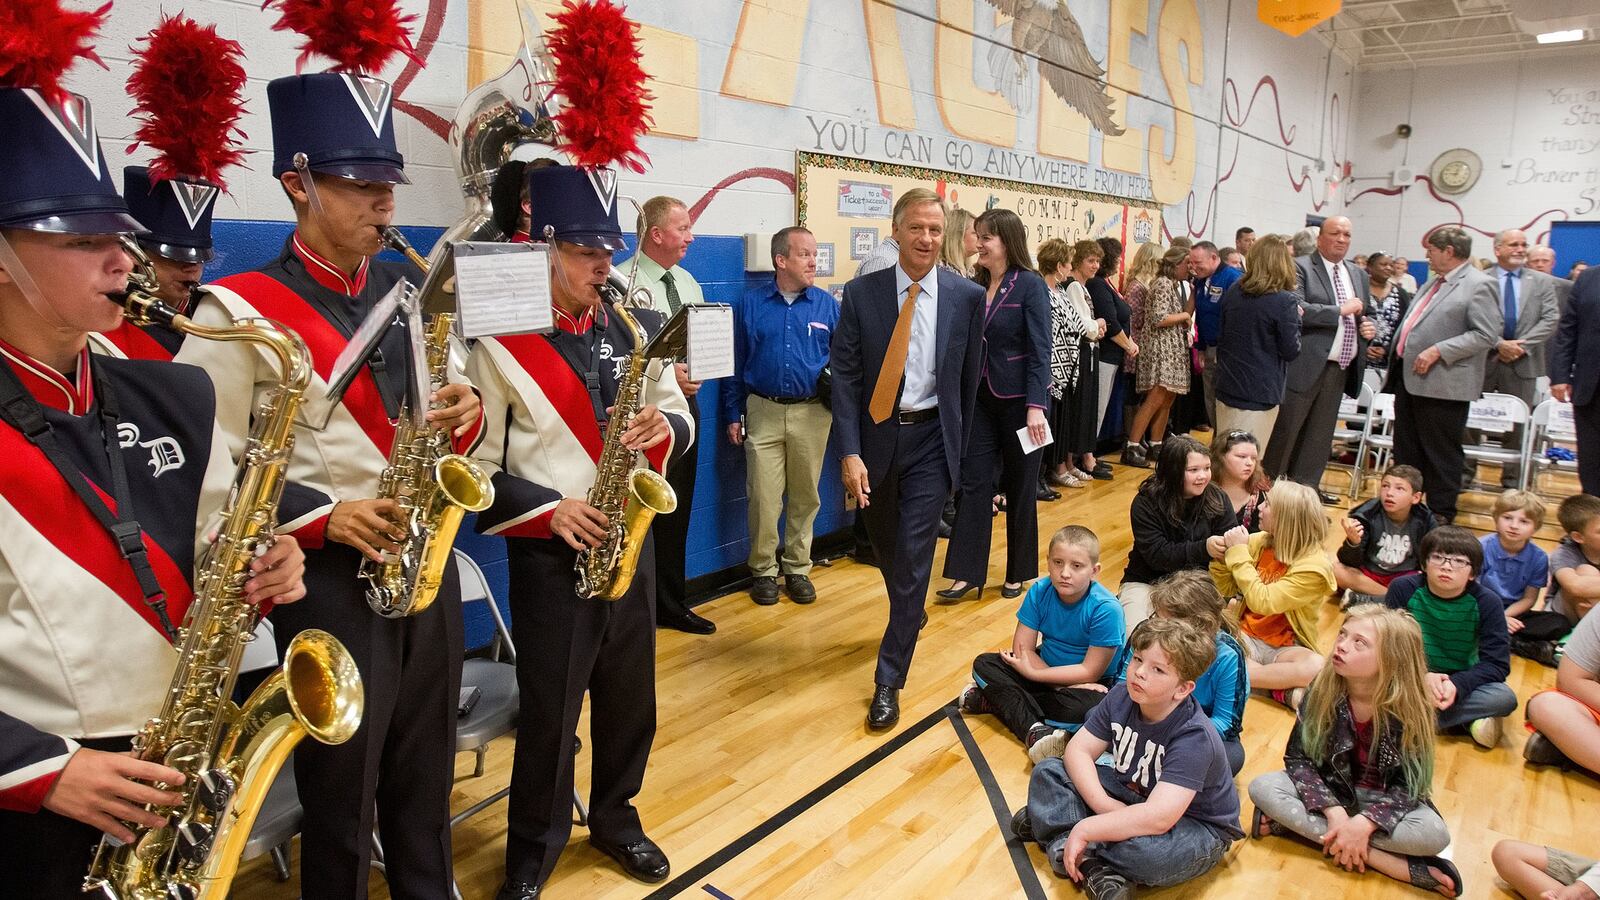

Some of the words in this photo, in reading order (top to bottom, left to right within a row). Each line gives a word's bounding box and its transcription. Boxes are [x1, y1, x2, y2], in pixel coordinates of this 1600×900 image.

[806, 115, 869, 156] YOU
[884, 131, 933, 164] CAN
[945, 141, 973, 170] GO
[983, 148, 1088, 189] ANYWHERE
[1094, 168, 1123, 195] FROM
[1127, 175, 1152, 199] HERE
[1506, 157, 1579, 185] Braver
[843, 195, 866, 205] Ticket
[1017, 196, 1079, 222] COMMIT
